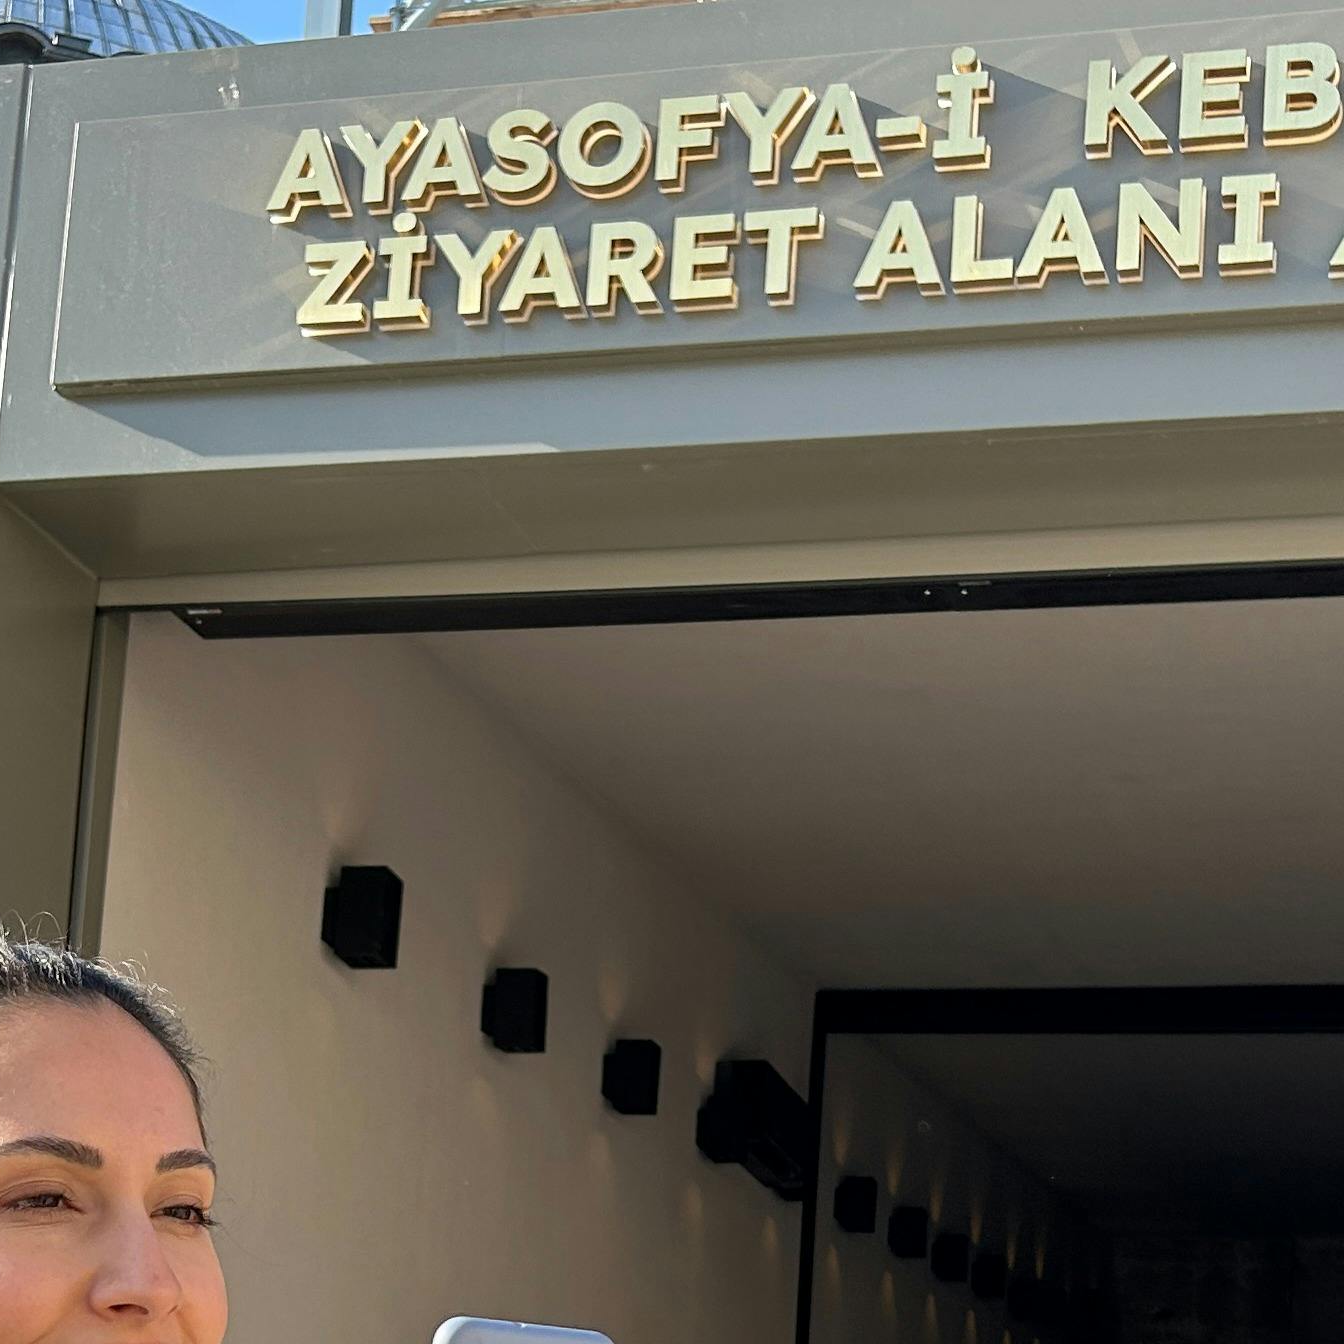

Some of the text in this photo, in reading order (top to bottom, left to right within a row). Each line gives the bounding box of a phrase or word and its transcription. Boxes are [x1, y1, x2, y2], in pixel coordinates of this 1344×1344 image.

[268, 46, 997, 224] AYASOFYA-İ
[296, 212, 826, 337] ZİYARET
[854, 173, 1281, 300] ALANI
